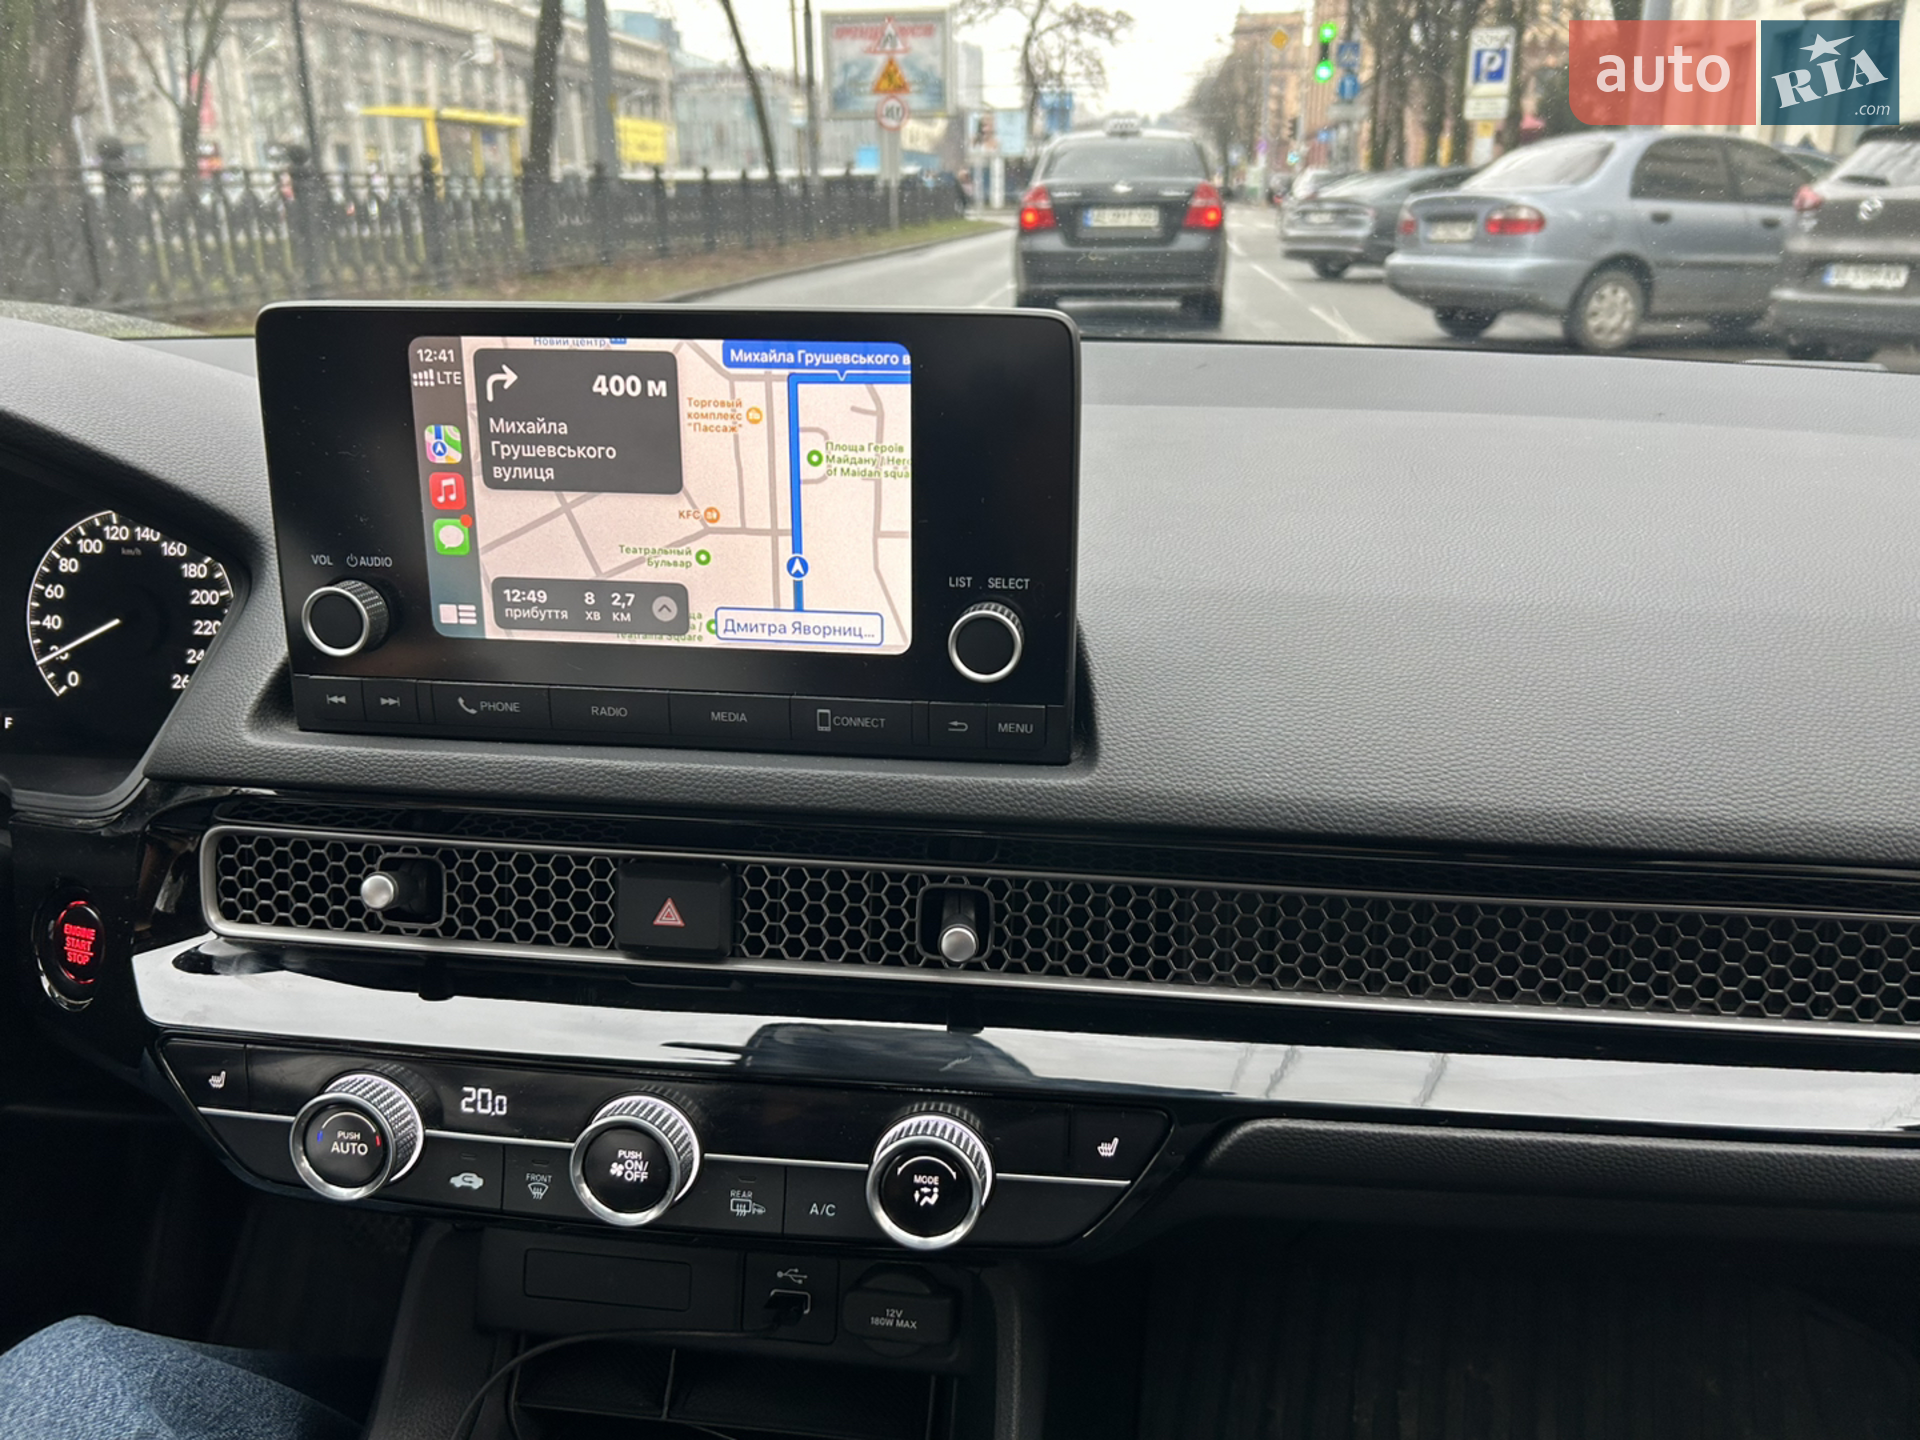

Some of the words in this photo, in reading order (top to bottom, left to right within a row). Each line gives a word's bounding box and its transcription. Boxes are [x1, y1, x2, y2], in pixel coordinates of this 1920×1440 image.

[417, 349, 455, 362] 12:41
[730, 349, 795, 364] Михайла
[797, 350, 898, 366] Грушевського
[437, 371, 462, 385] LTE
[592, 374, 642, 397] 400
[647, 380, 667, 397] м
[686, 397, 742, 409] Торговый
[687, 412, 742, 421] комплекс
[489, 418, 568, 434] Михайла
[687, 422, 743, 433] "Пассаж"
[491, 441, 616, 460] Грушевського
[825, 441, 865, 453] Площа
[826, 454, 877, 466] Майдану
[493, 466, 554, 481] вулиця
[826, 467, 837, 476] of
[841, 467, 881, 477] Maidan
[678, 510, 700, 520] KFC
[103, 525, 129, 541] 120
[134, 526, 160, 541] 140
[77, 539, 103, 554] 100
[161, 541, 187, 556] 160
[619, 545, 692, 556] Театральный
[58, 558, 79, 573] 80
[311, 555, 333, 565] VOL
[360, 556, 393, 568] AUDIO
[647, 556, 692, 569] Бульвар
[181, 563, 208, 579] 180
[949, 576, 972, 588] LIST
[988, 577, 1030, 590] SELECT
[44, 584, 64, 599] 60
[190, 590, 220, 605] 200
[503, 589, 548, 603] 12:49
[584, 592, 596, 605] 8
[611, 593, 636, 608] 2,7
[505, 607, 568, 620] прибуття
[585, 611, 601, 621] хв
[612, 612, 631, 622] км
[42, 615, 62, 630] 40
[193, 620, 221, 635] 220
[723, 618, 787, 635] Дмитра
[67, 671, 79, 687] 0
[480, 701, 521, 713] PHONE
[591, 706, 628, 717] RADIO
[4, 717, 13, 729] F
[711, 711, 748, 723] MEDIA
[833, 716, 886, 728] CONNECT
[998, 723, 1033, 734] MENU
[64, 923, 96, 940] ENGINE
[66, 936, 92, 951] START
[67, 952, 89, 965] STOP
[337, 1131, 361, 1141] PUSH
[331, 1141, 368, 1156] AUTO
[617, 1149, 643, 1160] PUSH
[624, 1159, 649, 1173] ON/
[525, 1172, 552, 1183] FRONT
[624, 1171, 649, 1182] OFF
[913, 1175, 939, 1185] MODE
[730, 1190, 753, 1199] REAR
[809, 1203, 836, 1217] A/C
[885, 1308, 903, 1318] 12V
[870, 1316, 894, 1327] 180W
[895, 1319, 917, 1330] MAX
